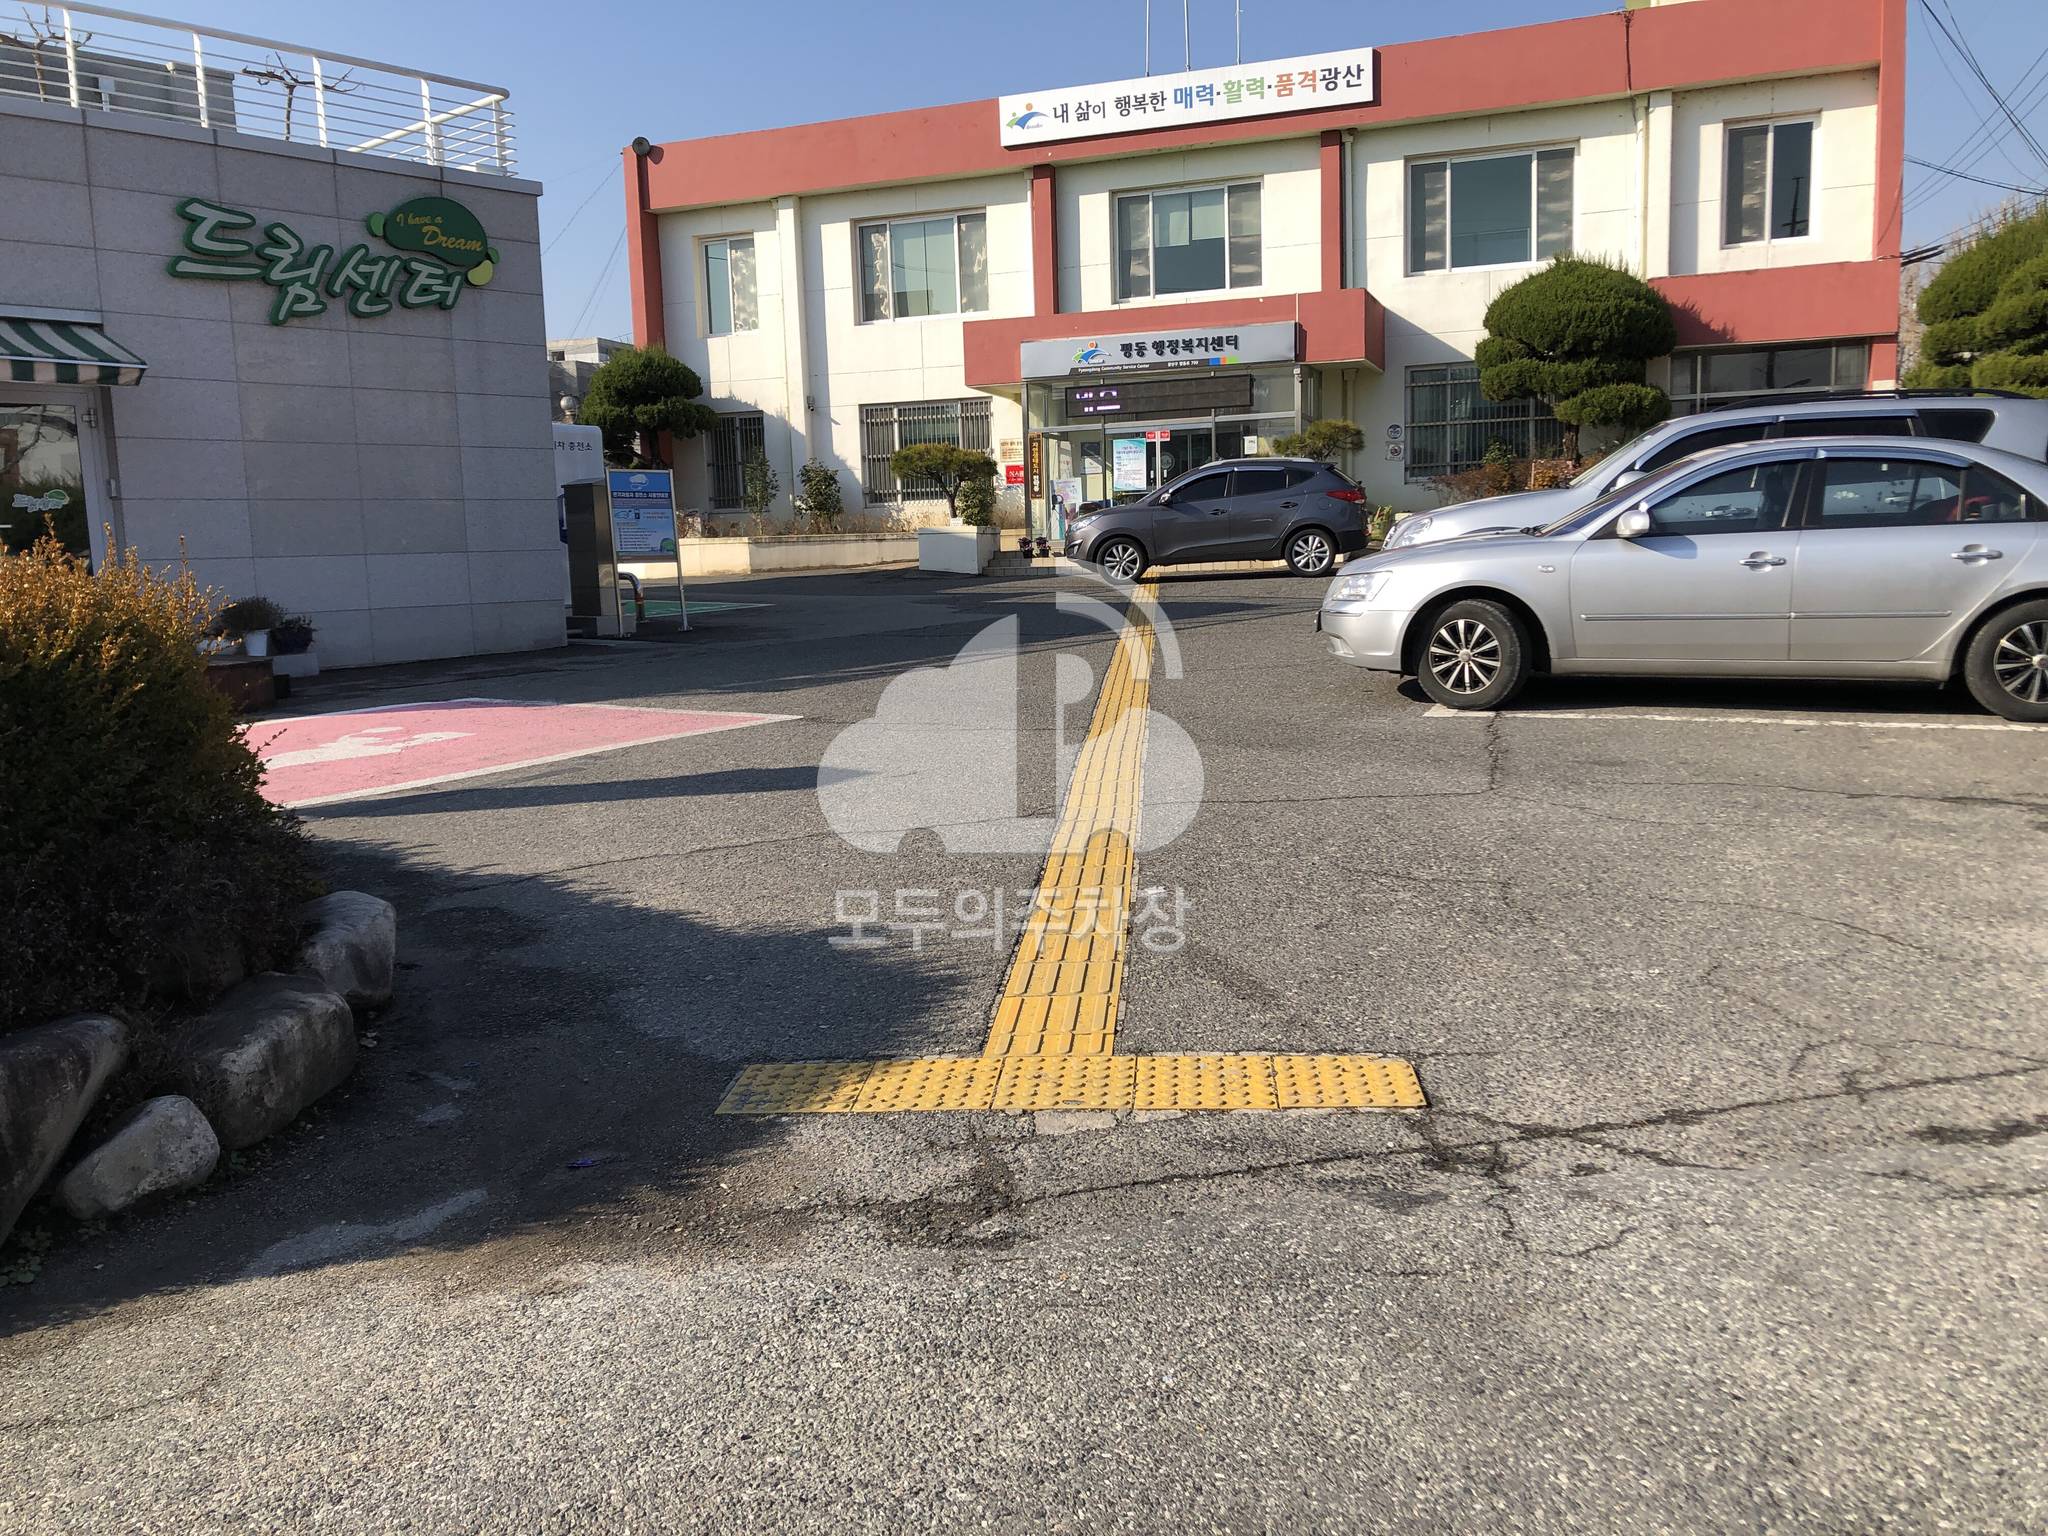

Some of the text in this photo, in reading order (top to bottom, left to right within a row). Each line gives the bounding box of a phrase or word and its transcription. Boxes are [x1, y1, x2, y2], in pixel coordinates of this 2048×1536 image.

[1052, 102, 1069, 124] 내
[1075, 100, 1106, 122] 삶이
[1114, 90, 1167, 114] 행복한
[396, 212, 443, 226] I have a
[421, 225, 483, 252] Dream
[170, 200, 463, 323] 드림센터
[1120, 334, 1240, 358] 평동 행정복지센터
[568, 440, 593, 452] 충전소
